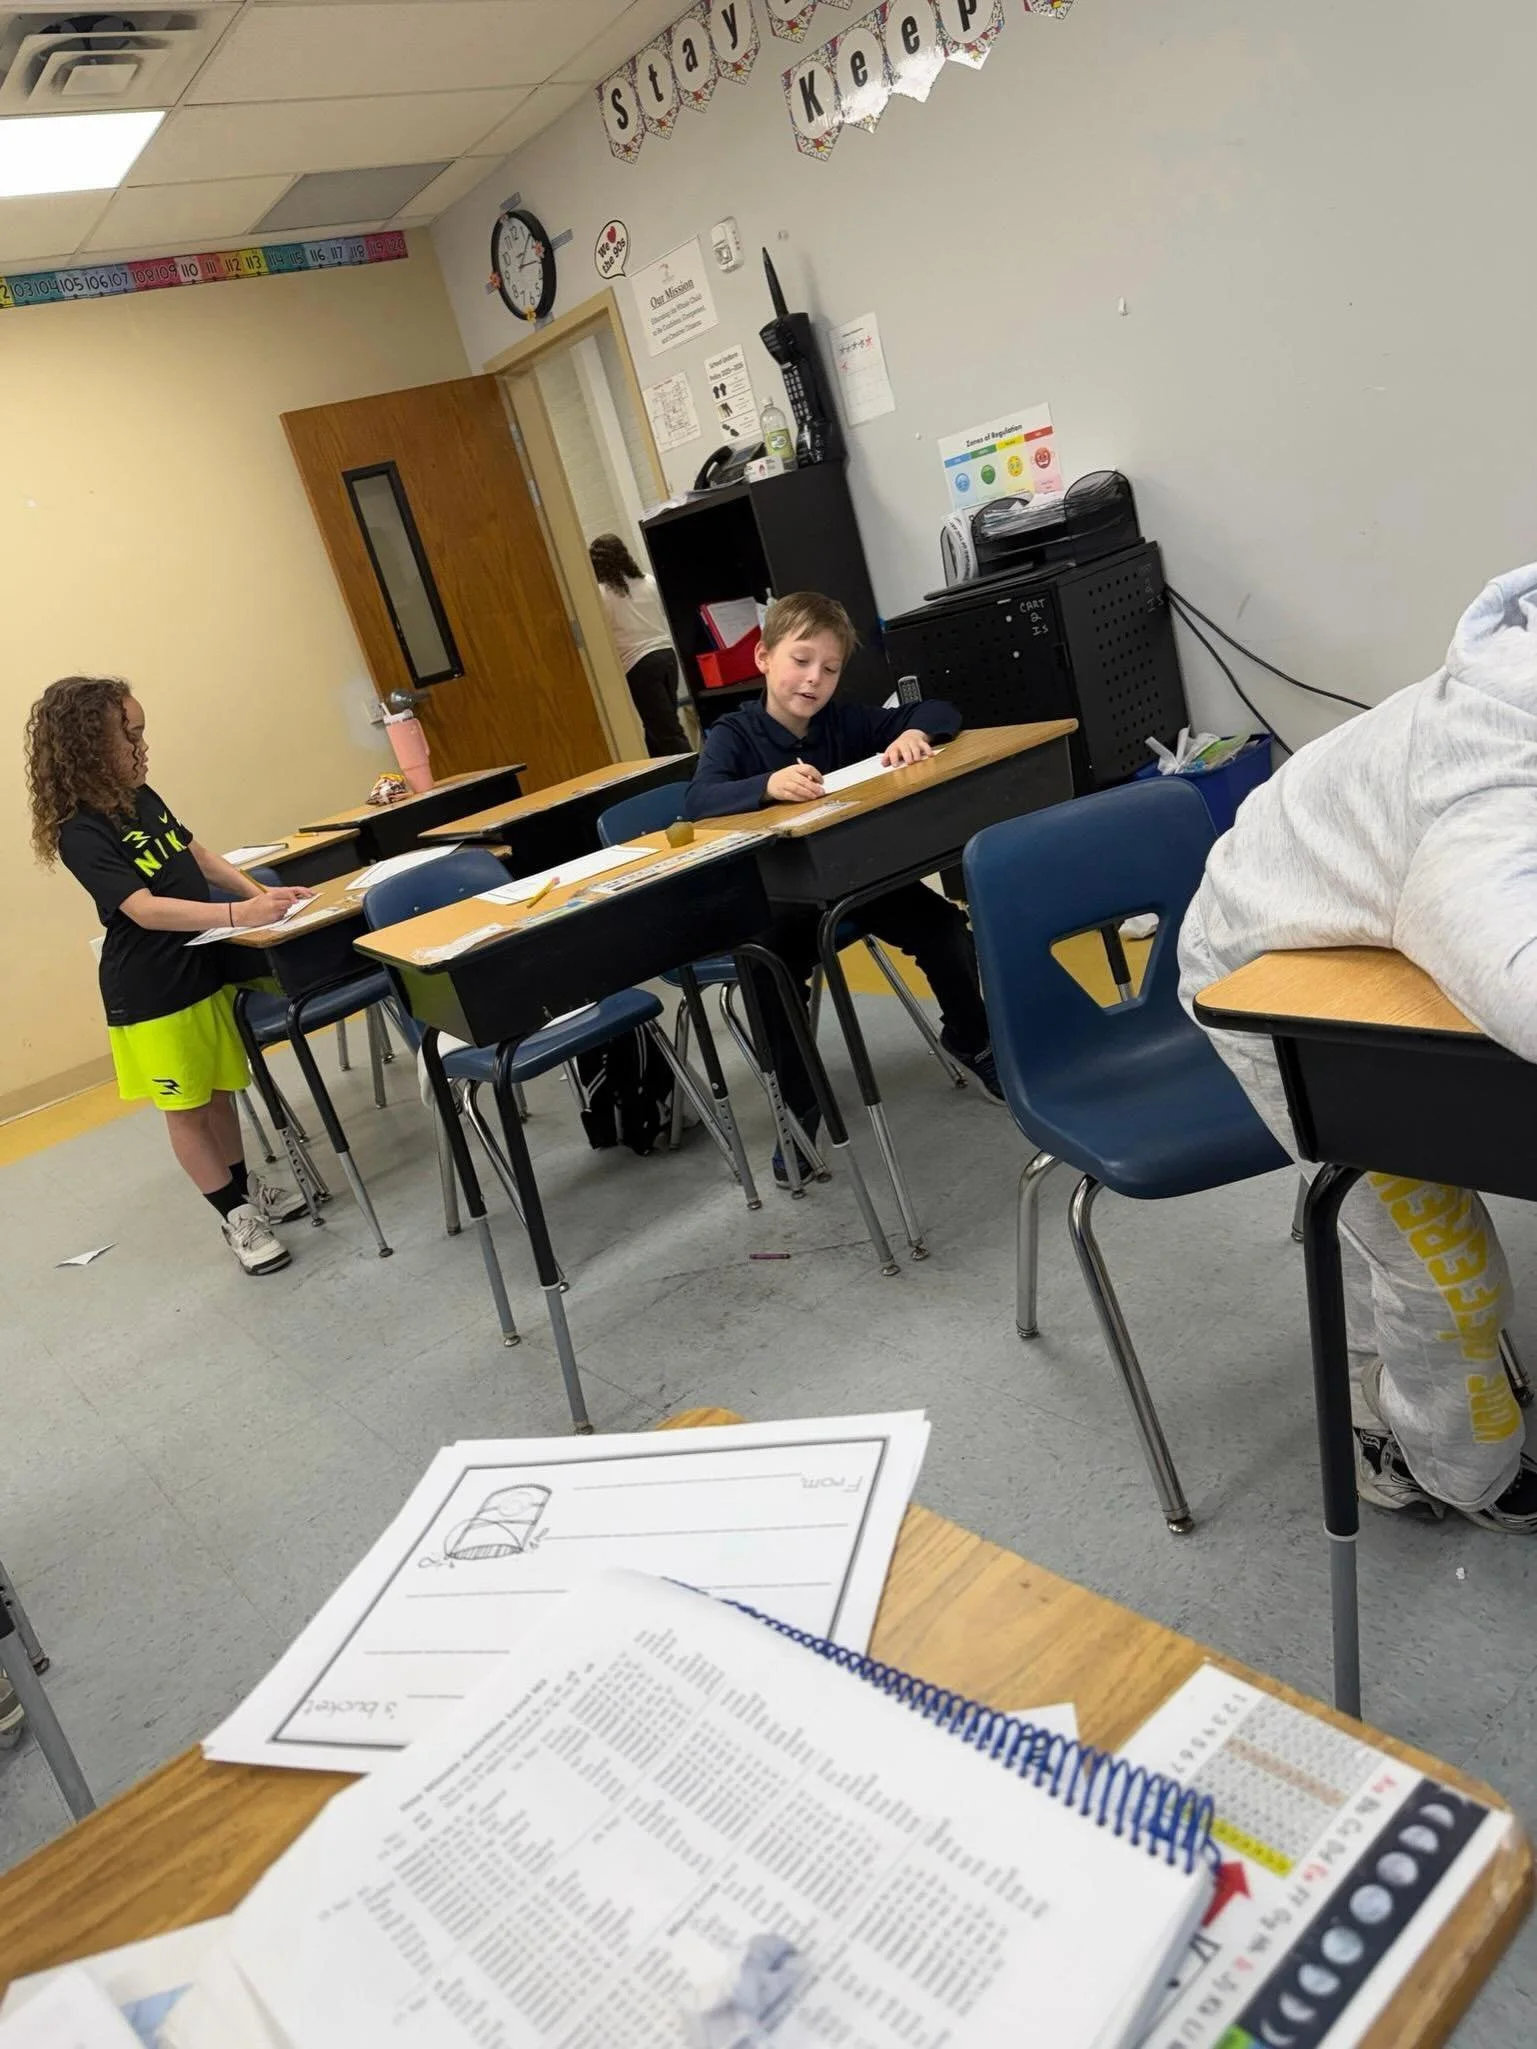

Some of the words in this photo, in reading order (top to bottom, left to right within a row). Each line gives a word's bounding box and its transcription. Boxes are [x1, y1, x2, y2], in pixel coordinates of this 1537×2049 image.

[611, 3, 738, 130] Stay
[798, 0, 978, 123] Keep
[598, 242, 611, 258] We
[603, 256, 614, 273] the
[613, 238, 626, 258] 90s
[10, 282, 34, 298] 103
[35, 279, 60, 295] 104
[60, 277, 84, 293] 105
[85, 273, 108, 290] 106
[108, 272, 129, 287] 107
[132, 269, 155, 283] 108
[155, 264, 178, 280] 109
[181, 263, 198, 278] 110
[205, 261, 217, 274] 111
[225, 258, 241, 272] 112
[245, 255, 261, 270] 113
[269, 251, 283, 266] 114
[289, 250, 305, 265] 115
[310, 248, 326, 262] 116
[330, 246, 343, 260] 117
[350, 244, 365, 259] 118
[368, 241, 384, 257] 119
[650, 295, 665, 310] Our
[664, 279, 695, 299] Mission
[966, 436, 984, 447] Zones
[984, 433, 991, 441] of
[991, 424, 1023, 440] Regulation
[1020, 599, 1046, 613] CART
[134, 830, 187, 878] NIK
